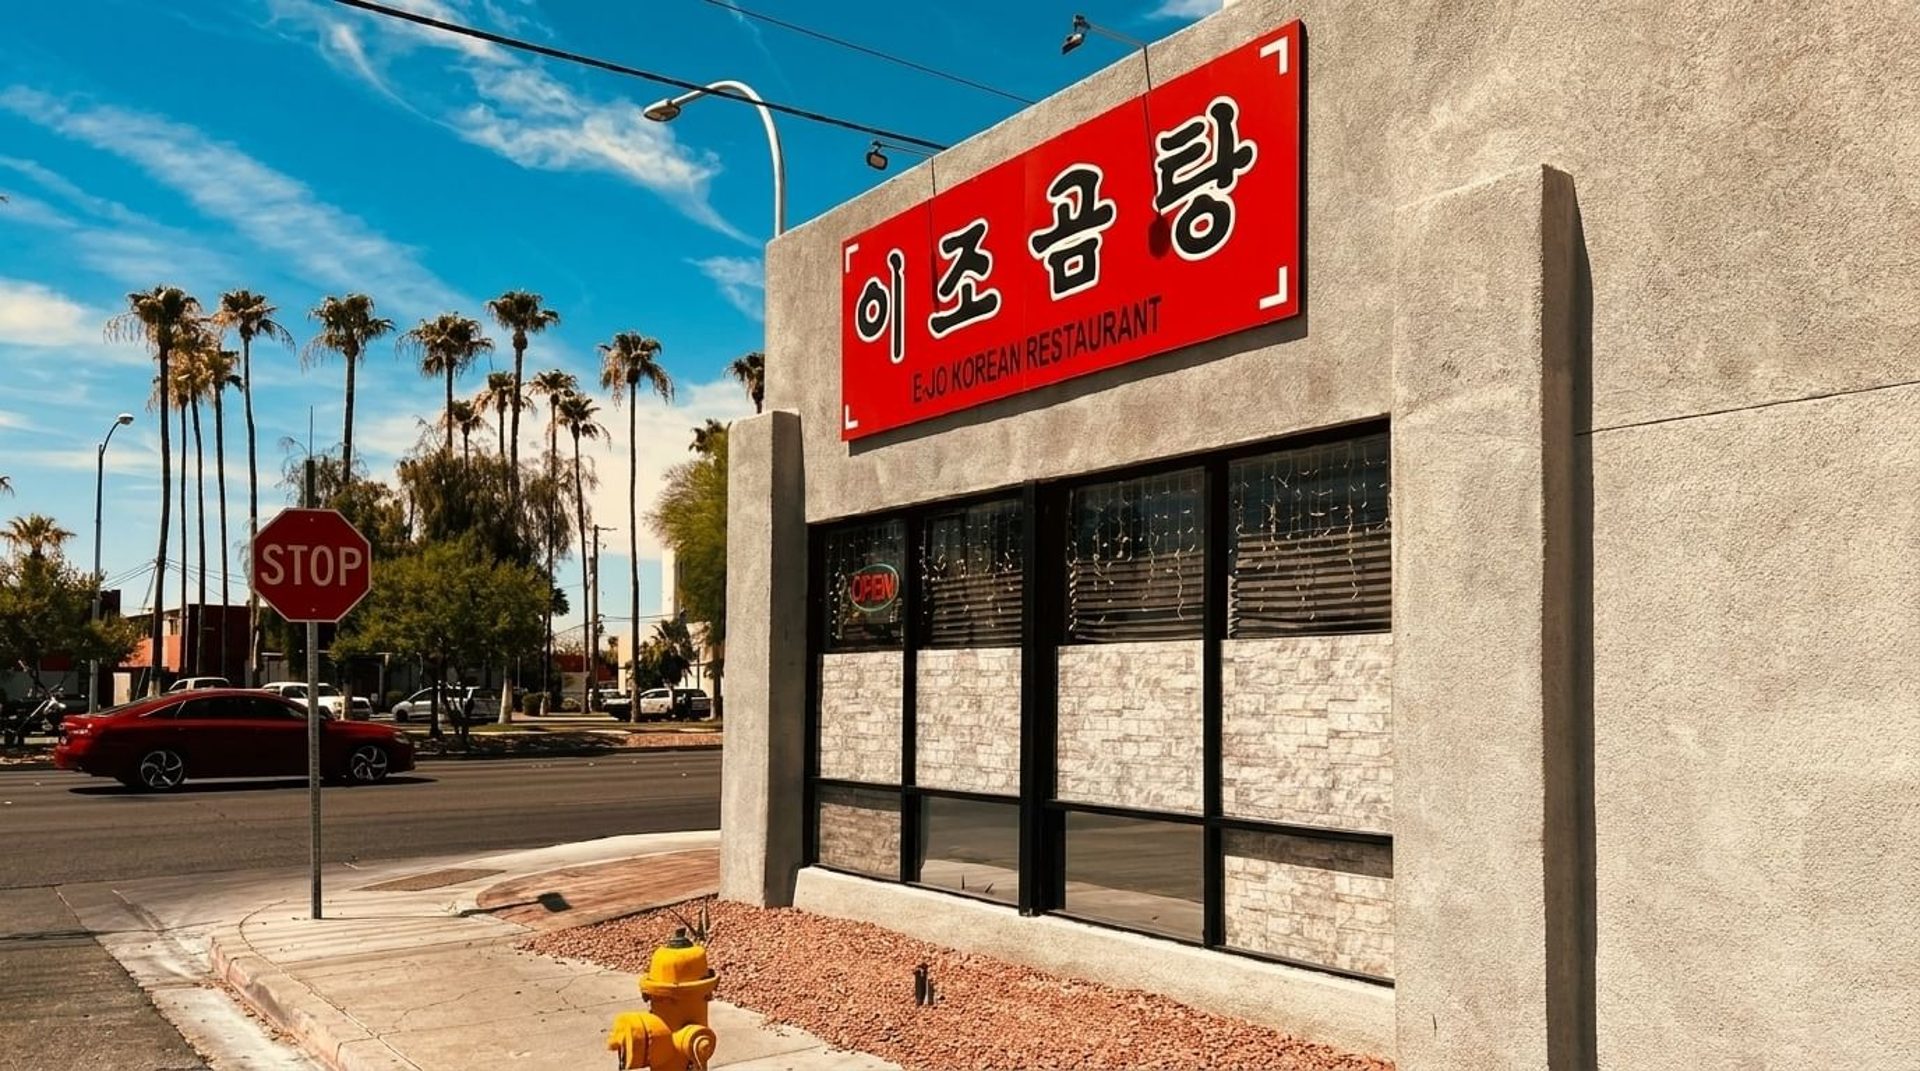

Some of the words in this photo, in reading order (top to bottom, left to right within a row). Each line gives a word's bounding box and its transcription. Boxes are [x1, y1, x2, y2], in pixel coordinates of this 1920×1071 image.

[855, 96, 1258, 363] 이조곰탕
[912, 365, 948, 402] E-JO
[951, 342, 1021, 392] KOREAN
[1026, 295, 1163, 373] RESTAURANT
[260, 543, 363, 586] STOP
[851, 572, 895, 602] OPEN
